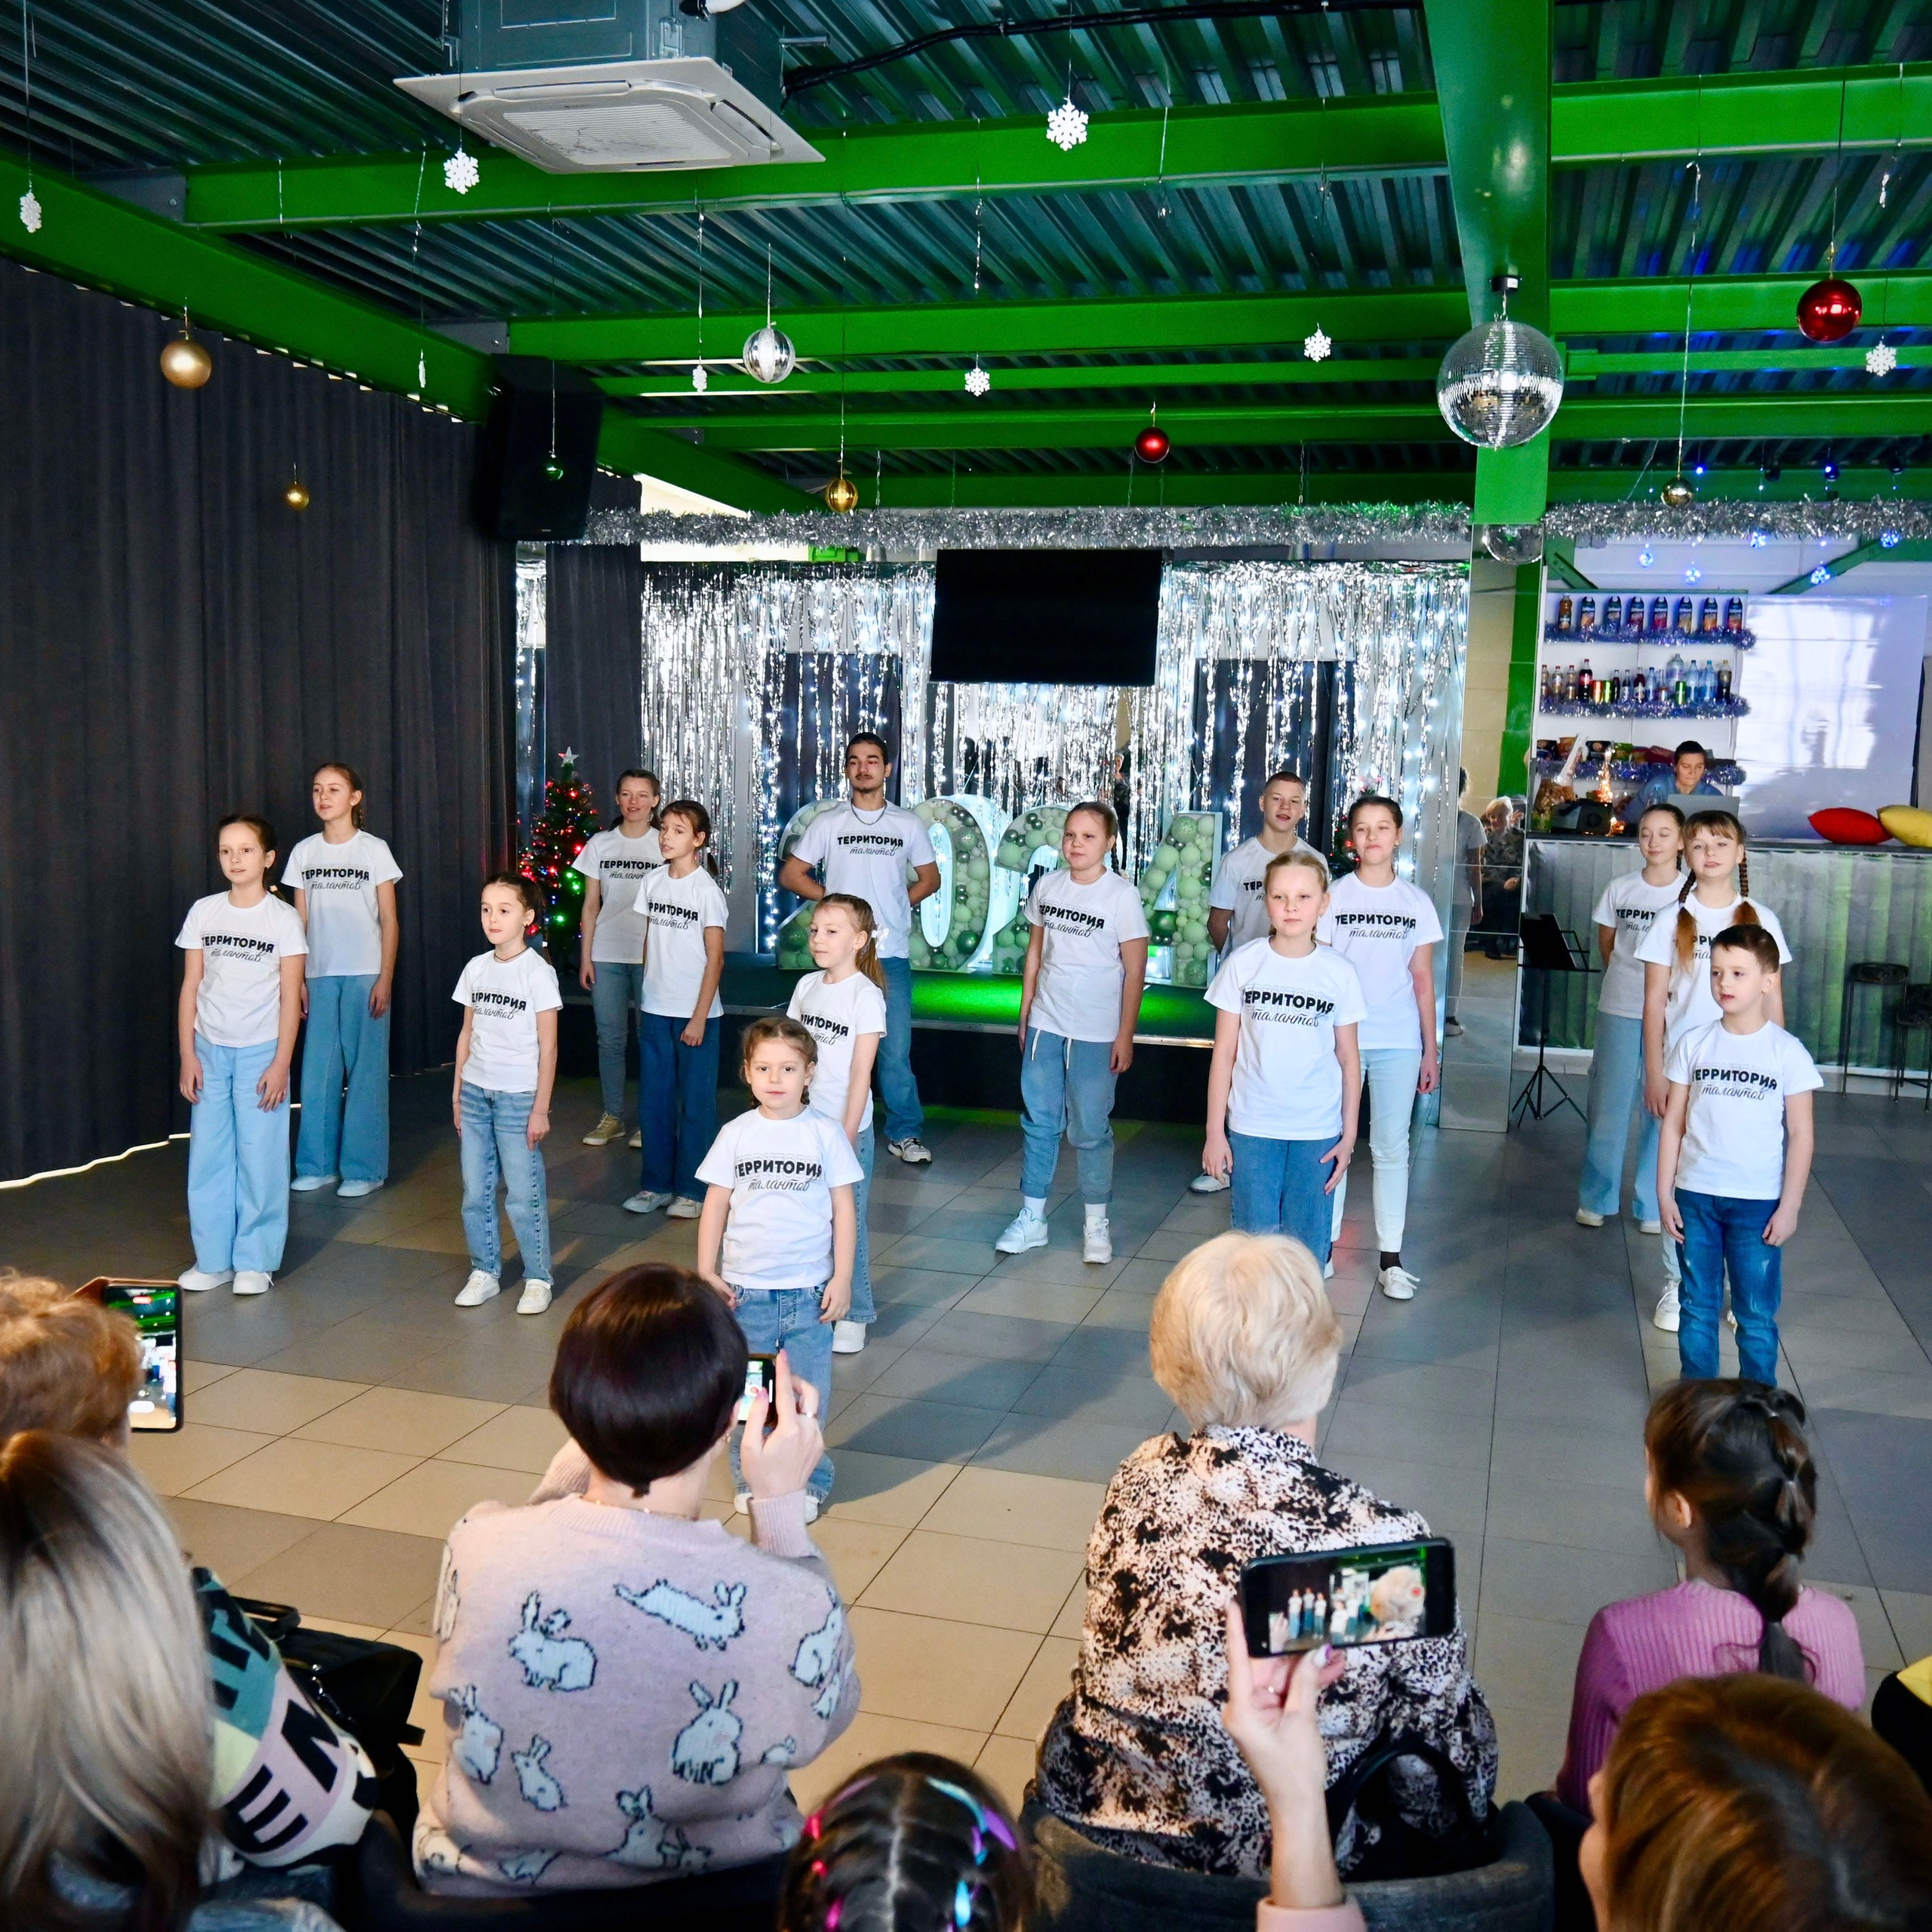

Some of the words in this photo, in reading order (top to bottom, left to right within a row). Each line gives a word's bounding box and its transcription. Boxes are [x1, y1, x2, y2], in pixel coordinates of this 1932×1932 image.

[837, 835, 903, 848] ТЕРРИТОРИЯ
[849, 846, 899, 857] талантов
[599, 860, 663, 870] ТЕРРИТОРИ
[311, 878, 365, 891] талантов
[648, 901, 699, 921] РРИТОРИЯ
[1616, 909, 1657, 921] ТЕРРИТ
[1044, 918, 1097, 938] талантов
[1335, 914, 1417, 930] ТЕРРИТОРИЯ
[1349, 925, 1411, 940] талантов
[1244, 990, 1335, 1014] ЕРРИТОРИЯ
[1251, 1008, 1325, 1027] талантов
[1701, 1084, 1769, 1101] талантов
[748, 1175, 817, 1192] талантов
